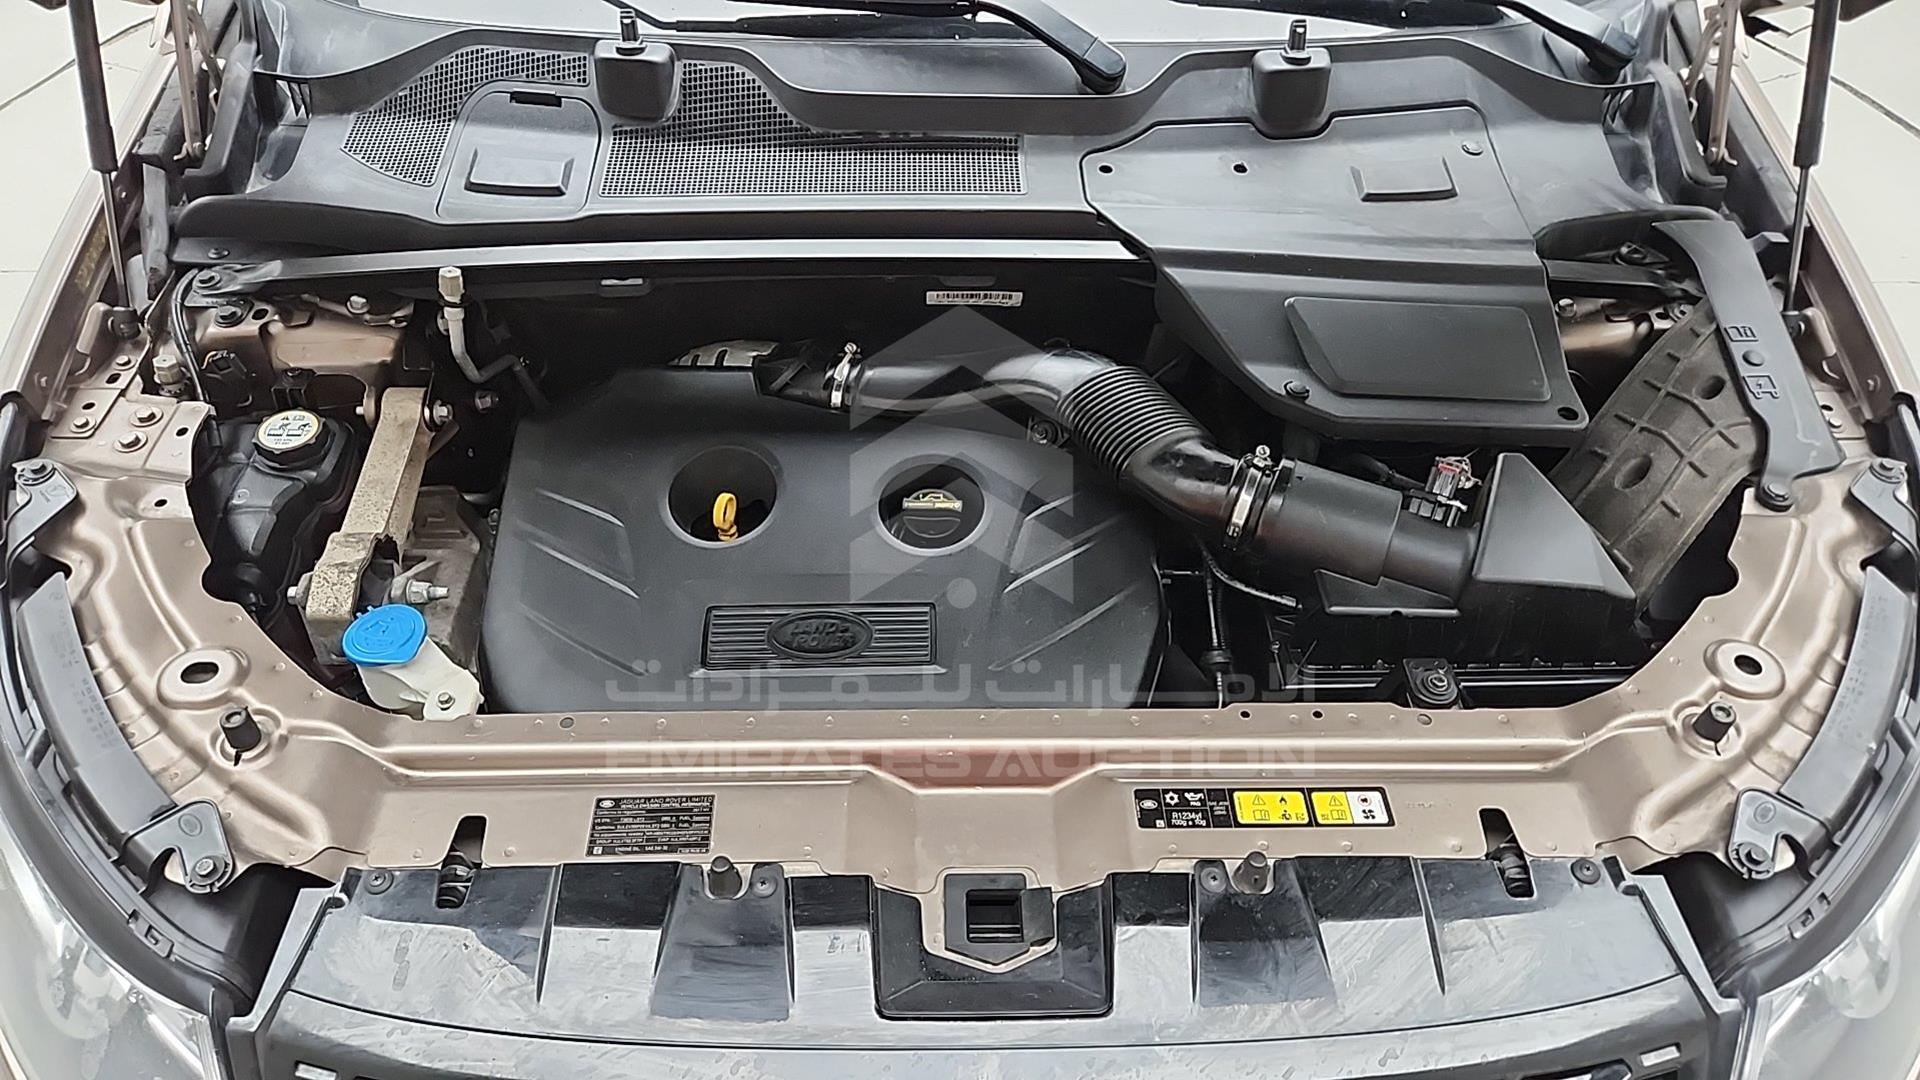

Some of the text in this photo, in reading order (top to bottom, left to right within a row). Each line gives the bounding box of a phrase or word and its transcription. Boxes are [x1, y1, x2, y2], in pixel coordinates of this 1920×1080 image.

[790, 620, 838, 635] LAND
[790, 634, 857, 648] ROVER
[1172, 811, 1203, 821] R1234yf
